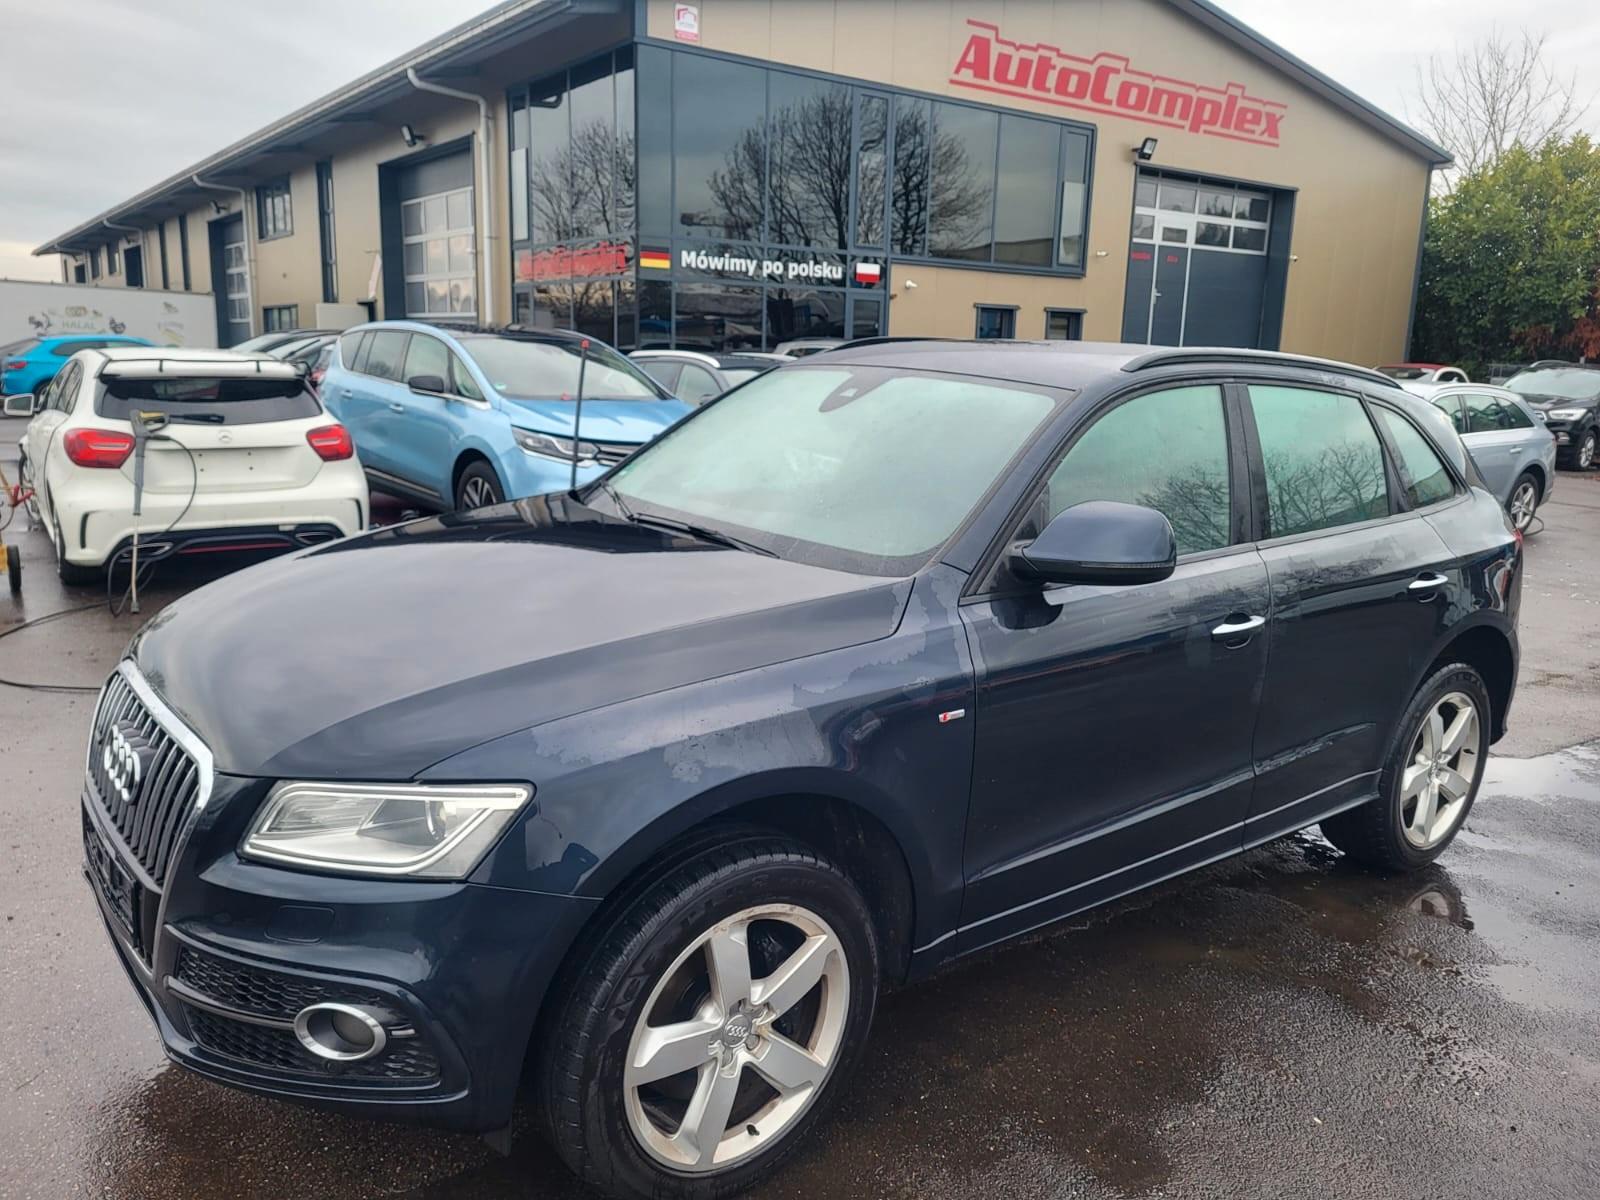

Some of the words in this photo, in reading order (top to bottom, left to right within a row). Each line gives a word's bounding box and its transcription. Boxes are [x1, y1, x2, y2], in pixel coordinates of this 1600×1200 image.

[953, 34, 1286, 139] AutoComplex
[680, 250, 756, 275] Mówimy
[762, 260, 784, 276] po
[788, 262, 843, 279] polsku
